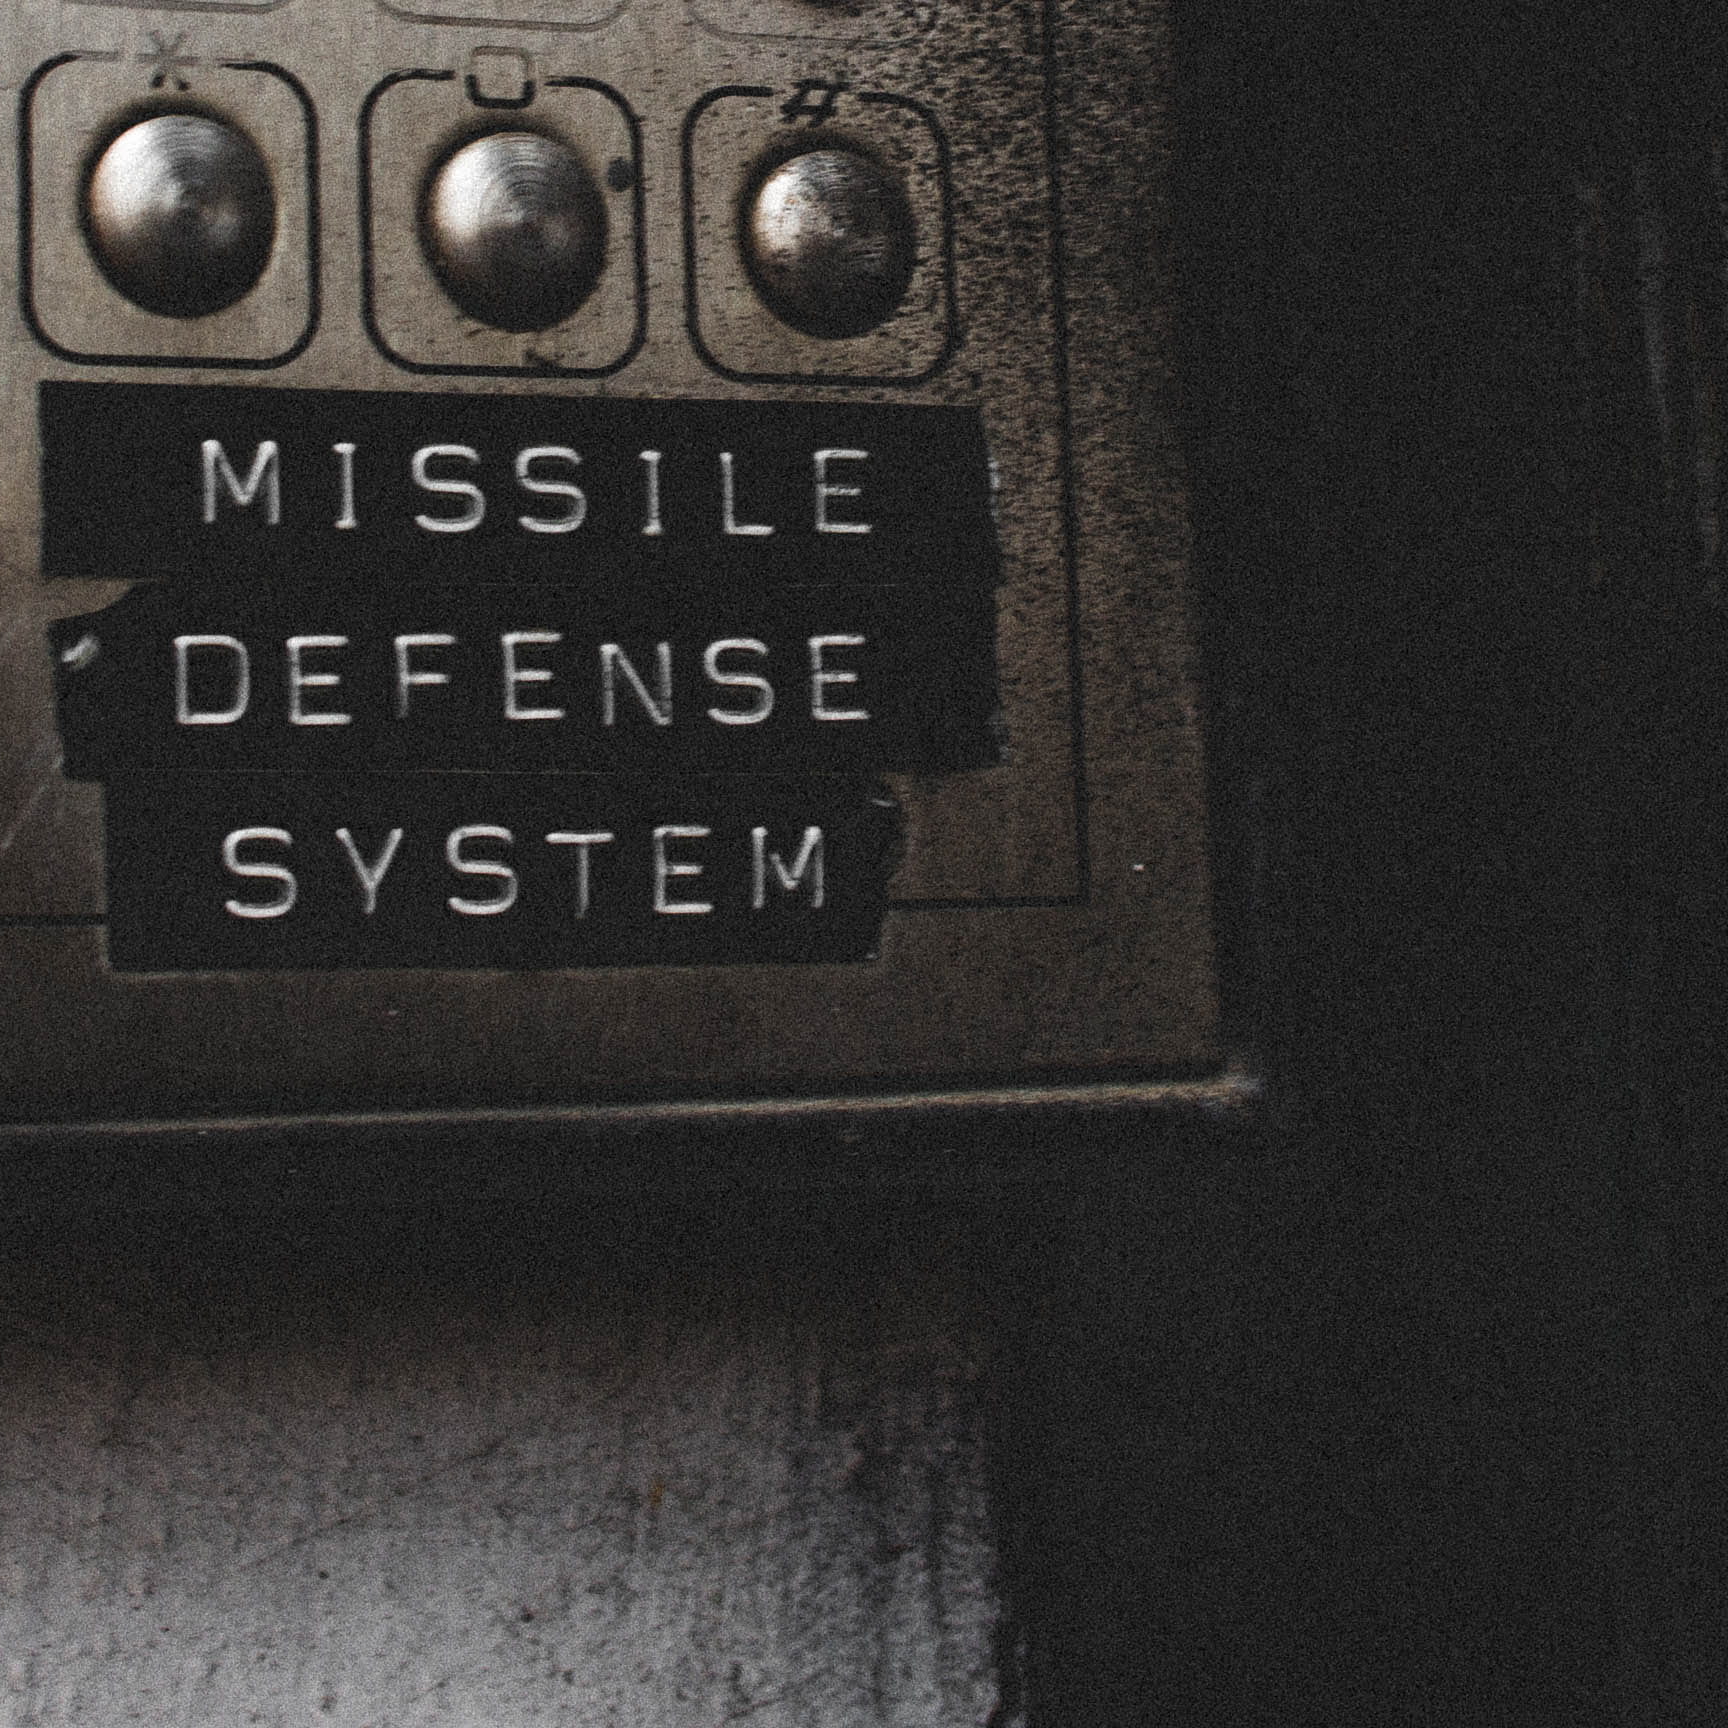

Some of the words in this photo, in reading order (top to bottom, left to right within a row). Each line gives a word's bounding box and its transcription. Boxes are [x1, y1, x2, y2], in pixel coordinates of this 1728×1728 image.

[464, 44, 535, 109] 0
[778, 76, 844, 128] #
[199, 438, 873, 537] MISSILE
[172, 630, 872, 728] DEFENSE
[221, 823, 827, 918] SYSTEM
